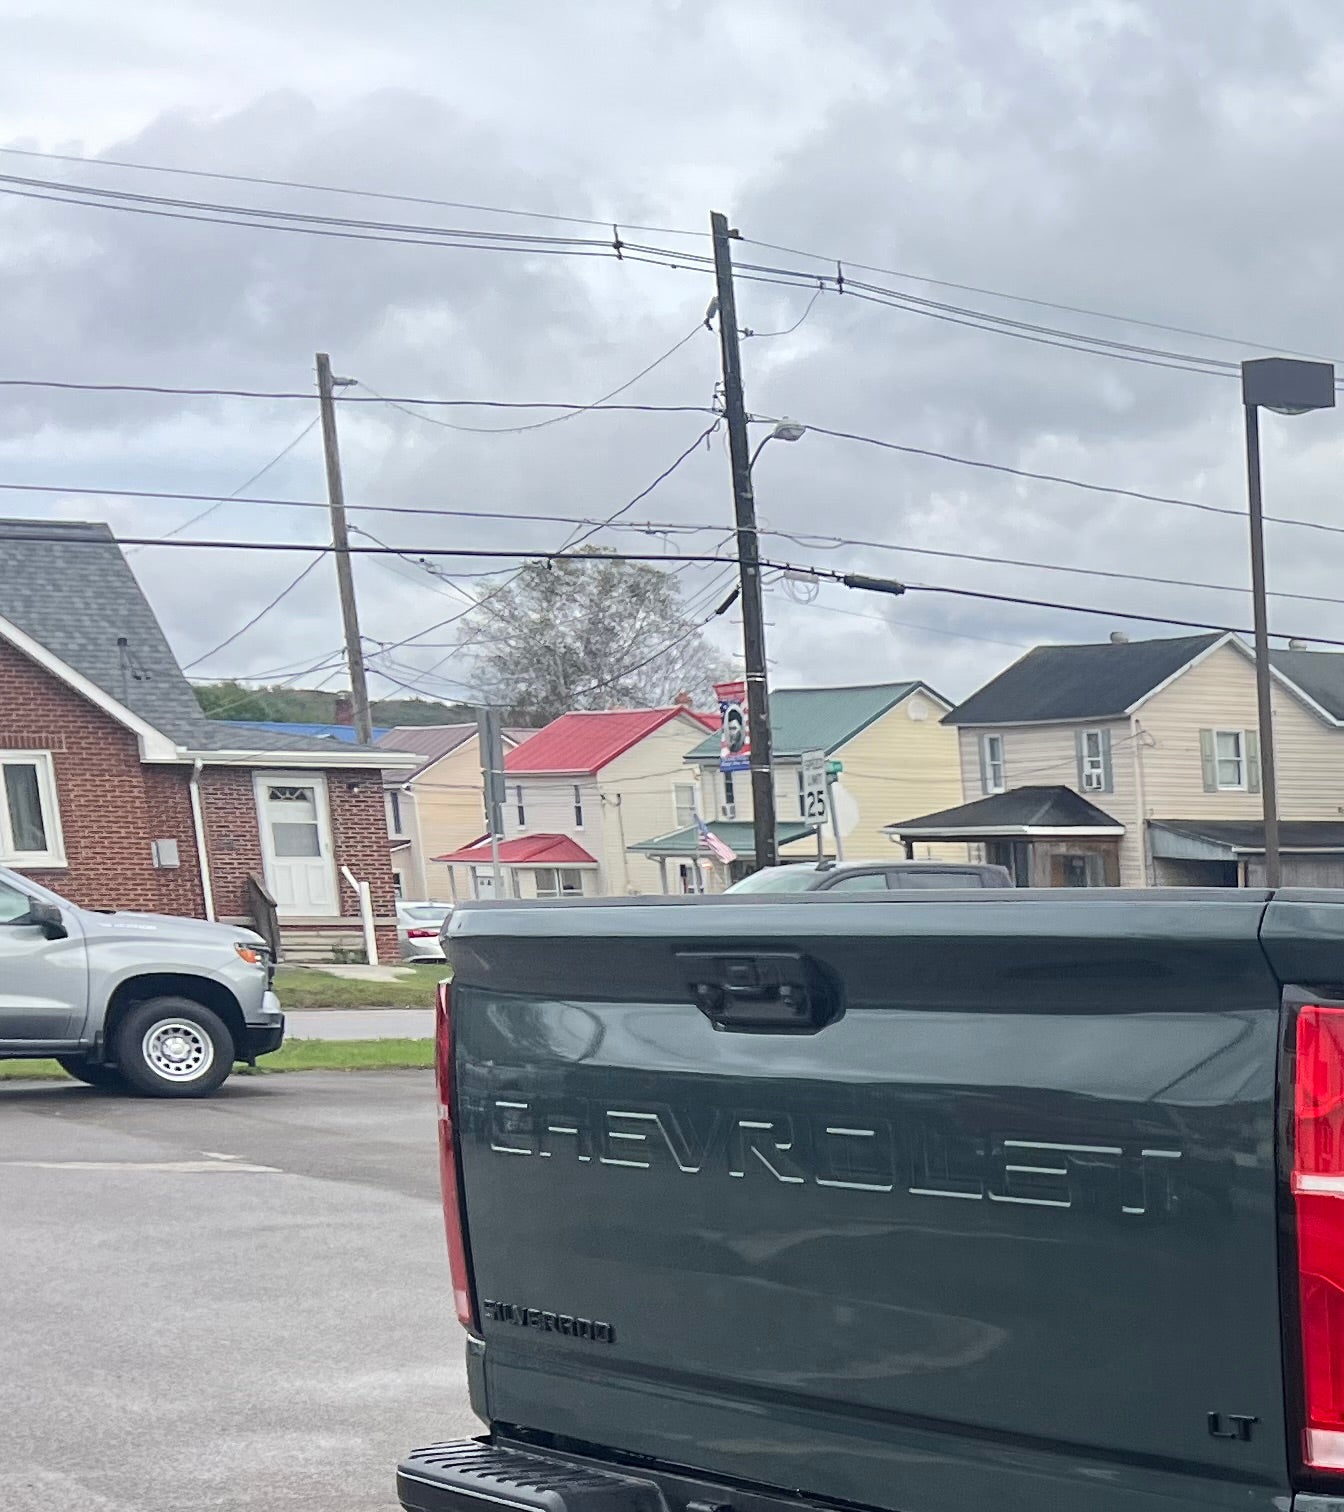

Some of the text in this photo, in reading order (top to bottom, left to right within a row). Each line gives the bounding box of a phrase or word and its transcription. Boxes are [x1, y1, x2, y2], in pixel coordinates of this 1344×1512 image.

[807, 790, 825, 817] 25
[490, 1098, 1183, 1214] CHEVROLET
[483, 1299, 617, 1343] SILVERADO
[1207, 1411, 1259, 1442] LT
